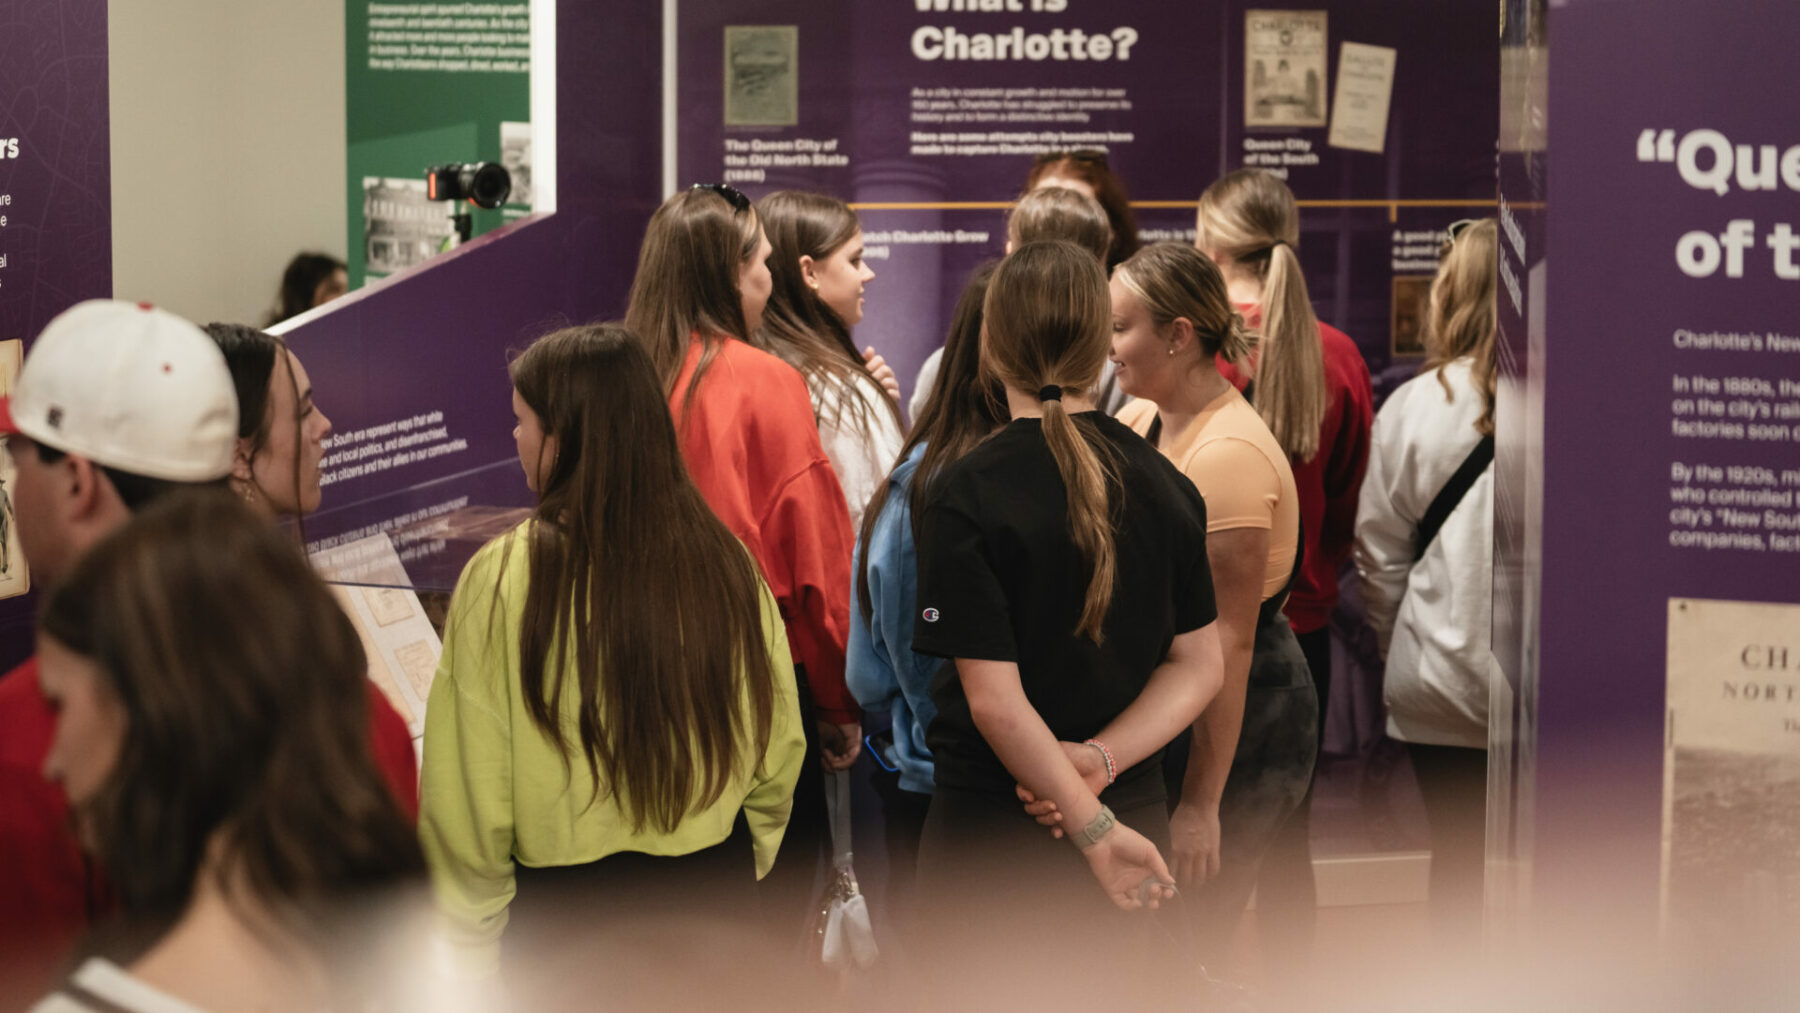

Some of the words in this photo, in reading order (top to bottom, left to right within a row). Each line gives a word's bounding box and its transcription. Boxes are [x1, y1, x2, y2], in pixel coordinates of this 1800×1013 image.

[911, 25, 1138, 61] Charlotte?
[911, 87, 925, 98] As
[934, 87, 950, 98] city
[952, 87, 961, 98] in
[962, 87, 1003, 98] constant
[1004, 87, 1037, 98] growth
[1038, 87, 1056, 98] and
[1058, 87, 1091, 98] motion
[1092, 87, 1104, 98] for
[1106, 87, 1126, 98] over
[958, 100, 1002, 110] Charlotte
[1003, 100, 1020, 110] has
[1022, 100, 1067, 110] struggled
[1068, 100, 1078, 110] to
[1079, 100, 1119, 110] preserve
[1120, 100, 1132, 110] its
[911, 112, 943, 123] history
[945, 112, 964, 123] and
[965, 112, 975, 123] to
[976, 112, 999, 123] form
[1007, 112, 1055, 123] distinctive
[725, 139, 750, 152] The
[751, 139, 794, 152] Queen
[794, 139, 821, 152] City
[822, 139, 838, 152] of
[911, 132, 938, 143] Here
[939, 132, 957, 143] are
[957, 132, 988, 143] some
[988, 132, 1038, 143] attempts
[1039, 132, 1060, 143] city
[1060, 132, 1107, 143] boosters
[1107, 132, 1134, 143] have
[1244, 138, 1285, 151] Queen
[1286, 138, 1312, 151] City
[724, 153, 748, 166] the
[749, 153, 773, 166] Old
[773, 153, 812, 166] North
[812, 153, 849, 166] State
[911, 145, 942, 154] made
[943, 145, 956, 154] to
[956, 145, 1000, 156] capture
[1000, 144, 1051, 154] Charlotte
[1243, 152, 1258, 165] of
[1259, 152, 1281, 165] the
[1282, 152, 1320, 165] South
[863, 230, 892, 244] atch
[892, 230, 954, 244] Charlotte
[954, 229, 989, 243] Grow
[1392, 230, 1403, 242] A
[1404, 230, 1435, 244] good
[1392, 246, 1402, 256] a
[1402, 246, 1433, 258] good
[1675, 219, 1755, 278] of
[1673, 329, 1763, 351] Charlotte's
[1672, 374, 1690, 393] In
[1692, 374, 1720, 394] the
[1723, 376, 1776, 398] 1880s,
[1671, 398, 1695, 415] on
[1697, 398, 1726, 417] the
[1727, 400, 1771, 421] city's
[320, 438, 333, 450] ew
[334, 431, 353, 448] South
[354, 430, 366, 441] era
[366, 421, 397, 439] represent
[397, 419, 413, 433] ways
[413, 413, 427, 427] that
[427, 410, 444, 424] white
[1672, 418, 1745, 440] factories
[1748, 423, 1790, 441] soon
[329, 452, 342, 467] and
[342, 447, 358, 464] local
[384, 439, 398, 452] and
[338, 463, 364, 482] citizens
[364, 459, 377, 475] and
[377, 456, 392, 471] their
[392, 452, 409, 467] allies
[409, 450, 417, 463] in
[416, 449, 428, 461] our
[1671, 461, 1693, 486] By
[1695, 464, 1724, 483] the
[1727, 466, 1778, 488] 1920s,
[1670, 485, 1706, 503] who
[1708, 487, 1793, 508] controlled
[1669, 507, 1713, 529] city's
[1669, 529, 1766, 551] companies,
[1740, 643, 1800, 671] CH
